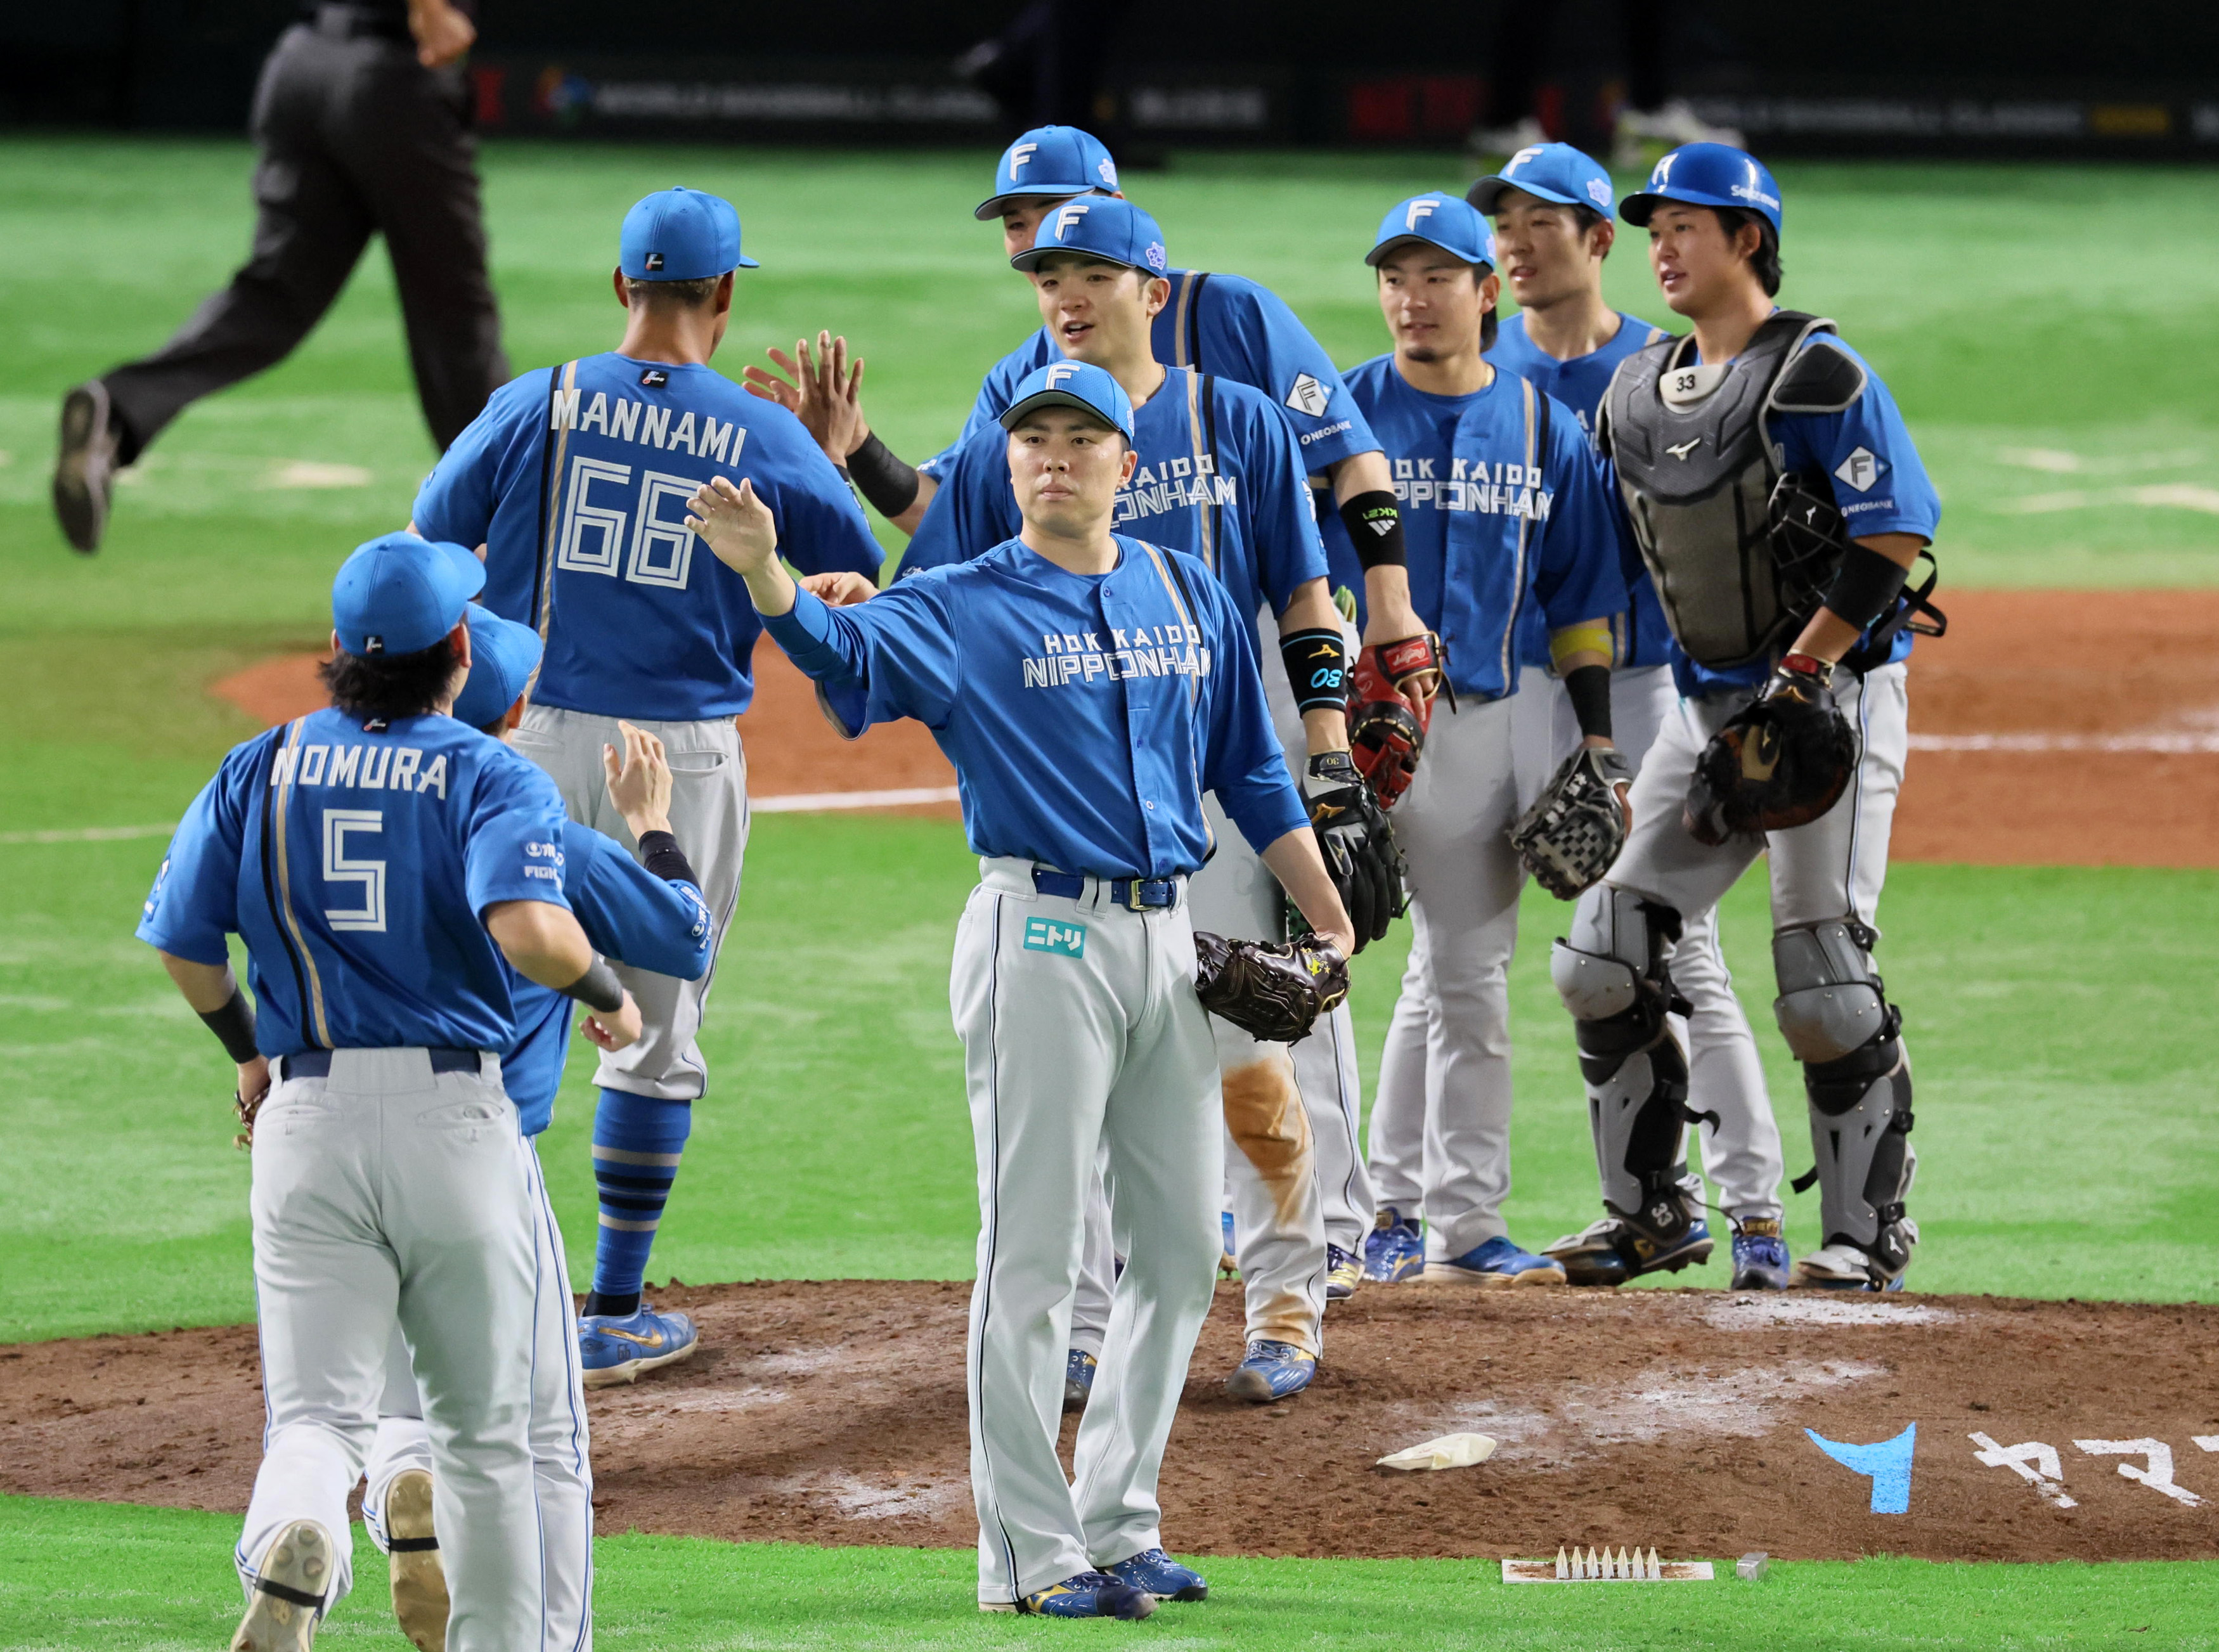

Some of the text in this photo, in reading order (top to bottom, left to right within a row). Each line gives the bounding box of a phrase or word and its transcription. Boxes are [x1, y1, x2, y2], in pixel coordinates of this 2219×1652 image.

[1010, 143, 1037, 182] F
[1505, 147, 1543, 177] F
[1056, 205, 1089, 241] F
[1406, 199, 1440, 231] F
[1045, 364, 1080, 390] F
[1676, 374, 1696, 392] 33
[1297, 380, 1317, 412] F
[551, 389, 747, 468] MANNAMI
[1310, 420, 1352, 441] NEOBANK
[1116, 453, 1215, 493] AIDO
[1851, 455, 1871, 486] F
[1110, 476, 1237, 529] ONHAM
[1393, 481, 1555, 521] PPONHAM
[558, 456, 702, 590] 66
[1022, 646, 1211, 688] NIPPONHAM
[1310, 668, 1343, 689] 30
[270, 744, 448, 801] NOMURA
[1326, 757, 1340, 766] 30
[322, 808, 387, 932] 5
[1028, 922, 1082, 951] ニトリ
[1652, 1202, 1674, 1227] 33
